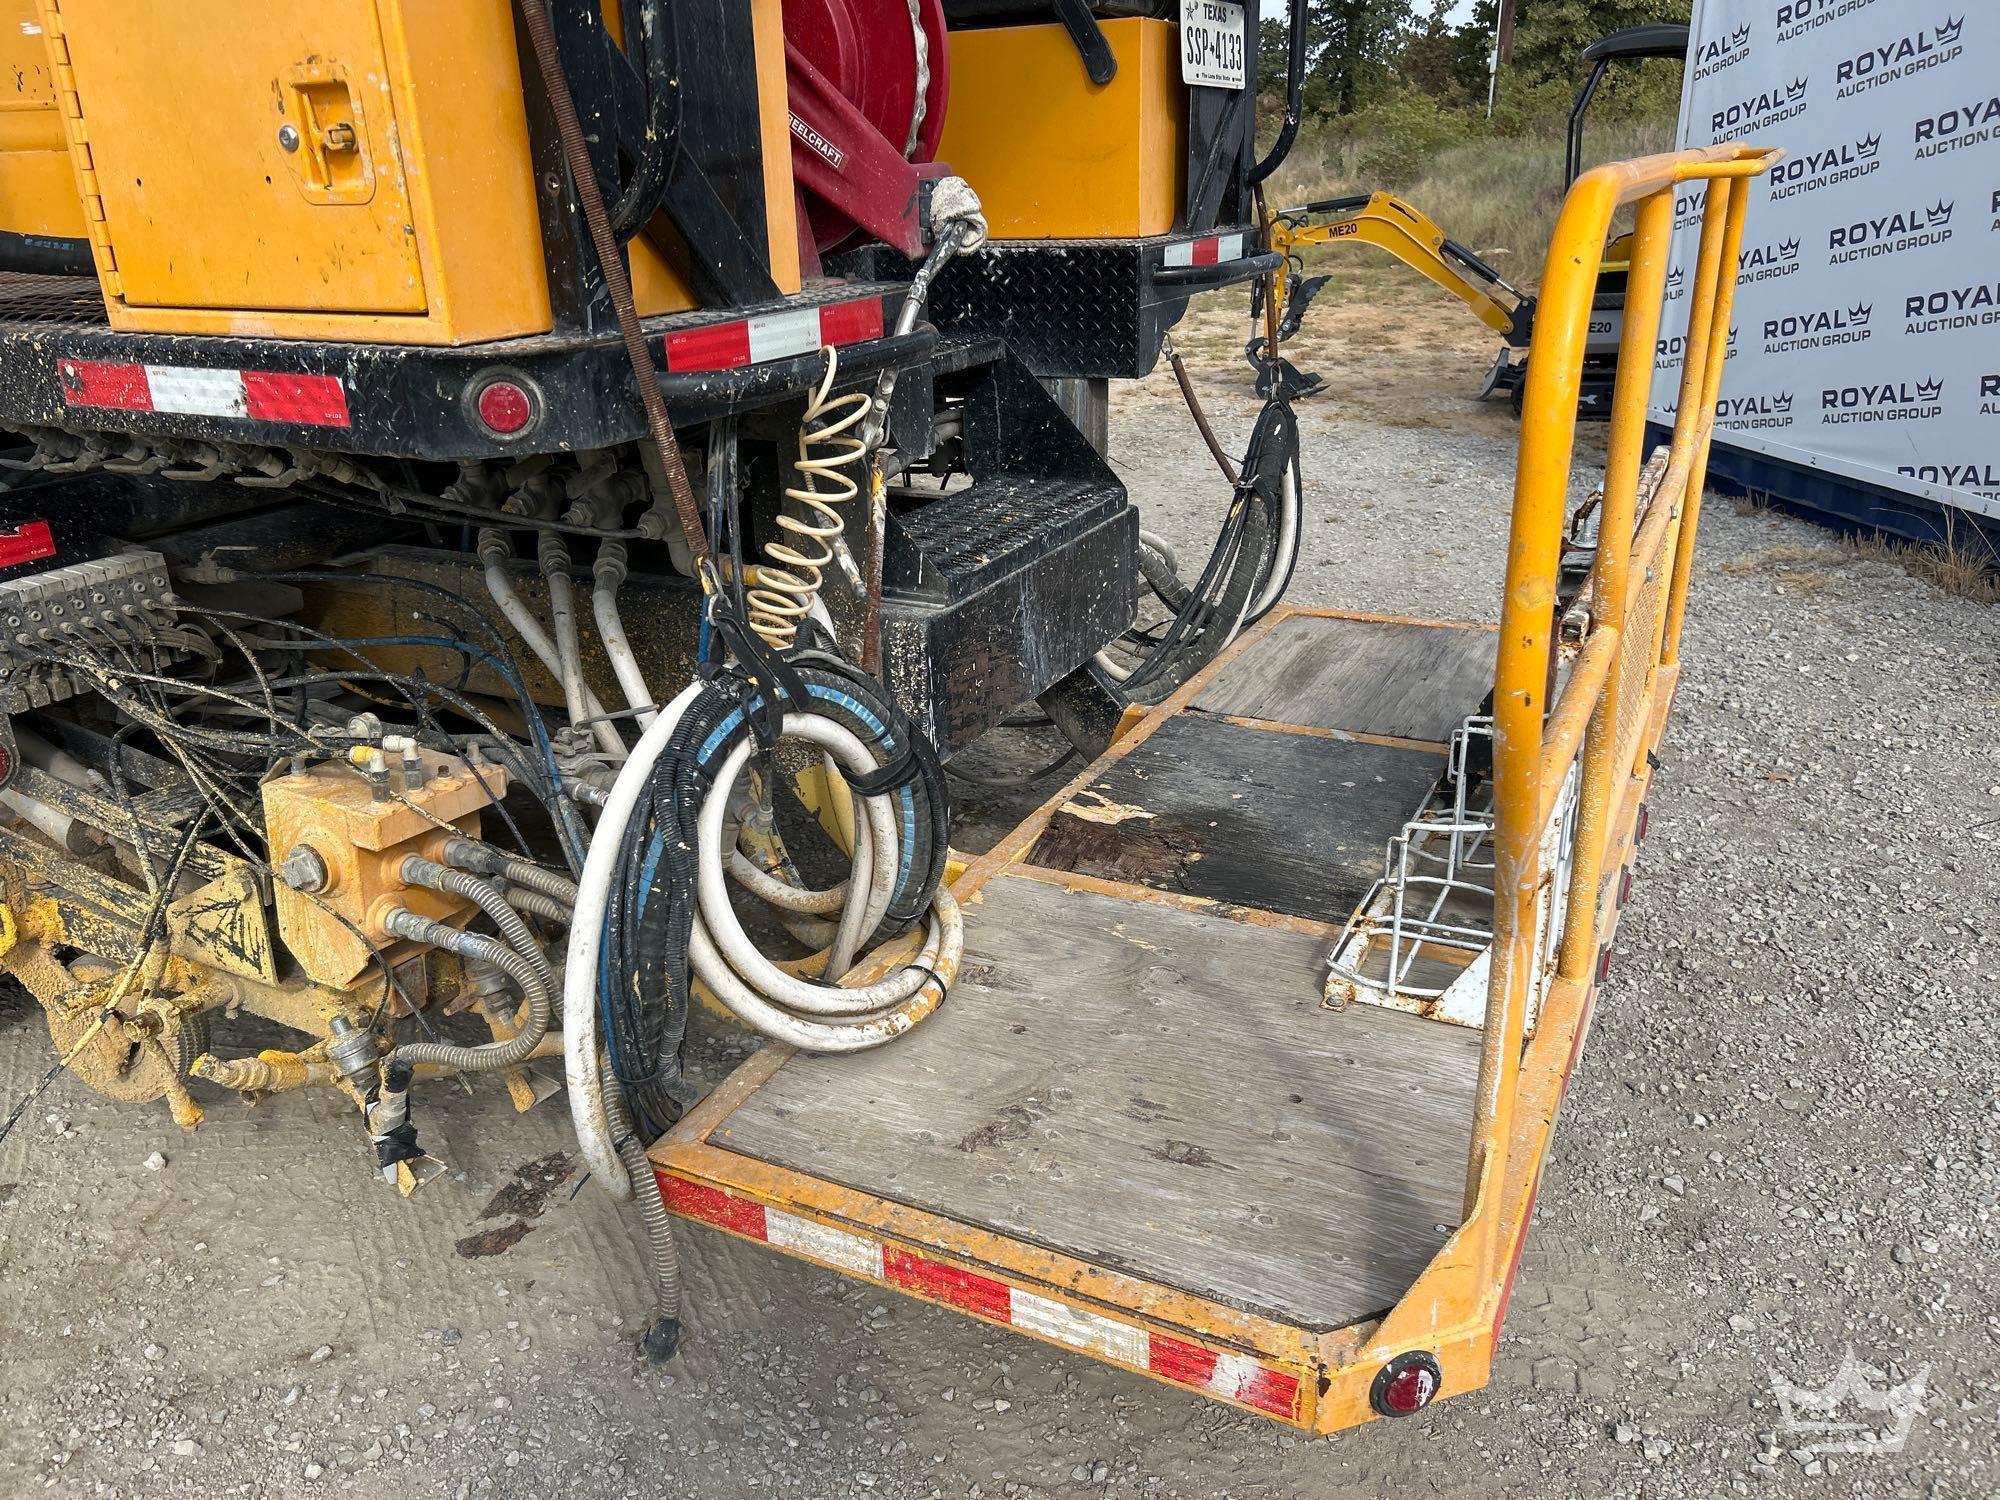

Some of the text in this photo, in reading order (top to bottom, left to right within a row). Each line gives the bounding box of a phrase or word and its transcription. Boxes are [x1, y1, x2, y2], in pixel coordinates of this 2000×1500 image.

[1203, 3, 1227, 23] TEXAS
[1776, 9, 1835, 44] AUCTION
[1712, 48, 1750, 74] GROUP
[1836, 32, 1934, 84] ROYAL
[1836, 45, 1963, 101] AUCTION GROUP
[1712, 89, 1785, 132] ROYAL
[1712, 102, 1807, 145] AUCTION GROUP
[1915, 129, 1989, 160] AUCTION
[1770, 144, 1855, 187] ROYAL
[1769, 160, 1880, 202] AUCTION GROUP
[1328, 223, 1357, 238] ME20
[1829, 211, 1925, 249] ROYAL
[1829, 230, 1953, 265] AUCTION GROUP
[1756, 263, 1799, 281] GROUP
[1764, 309, 1847, 339] ROYAL
[1905, 314, 1978, 334] AUCTION
[1764, 330, 1871, 354] AUCTION GROUP
[1822, 383, 1914, 409] ROYAL
[1751, 417, 1793, 429] GROUP
[1821, 406, 1942, 425] AUCTION GROUP
